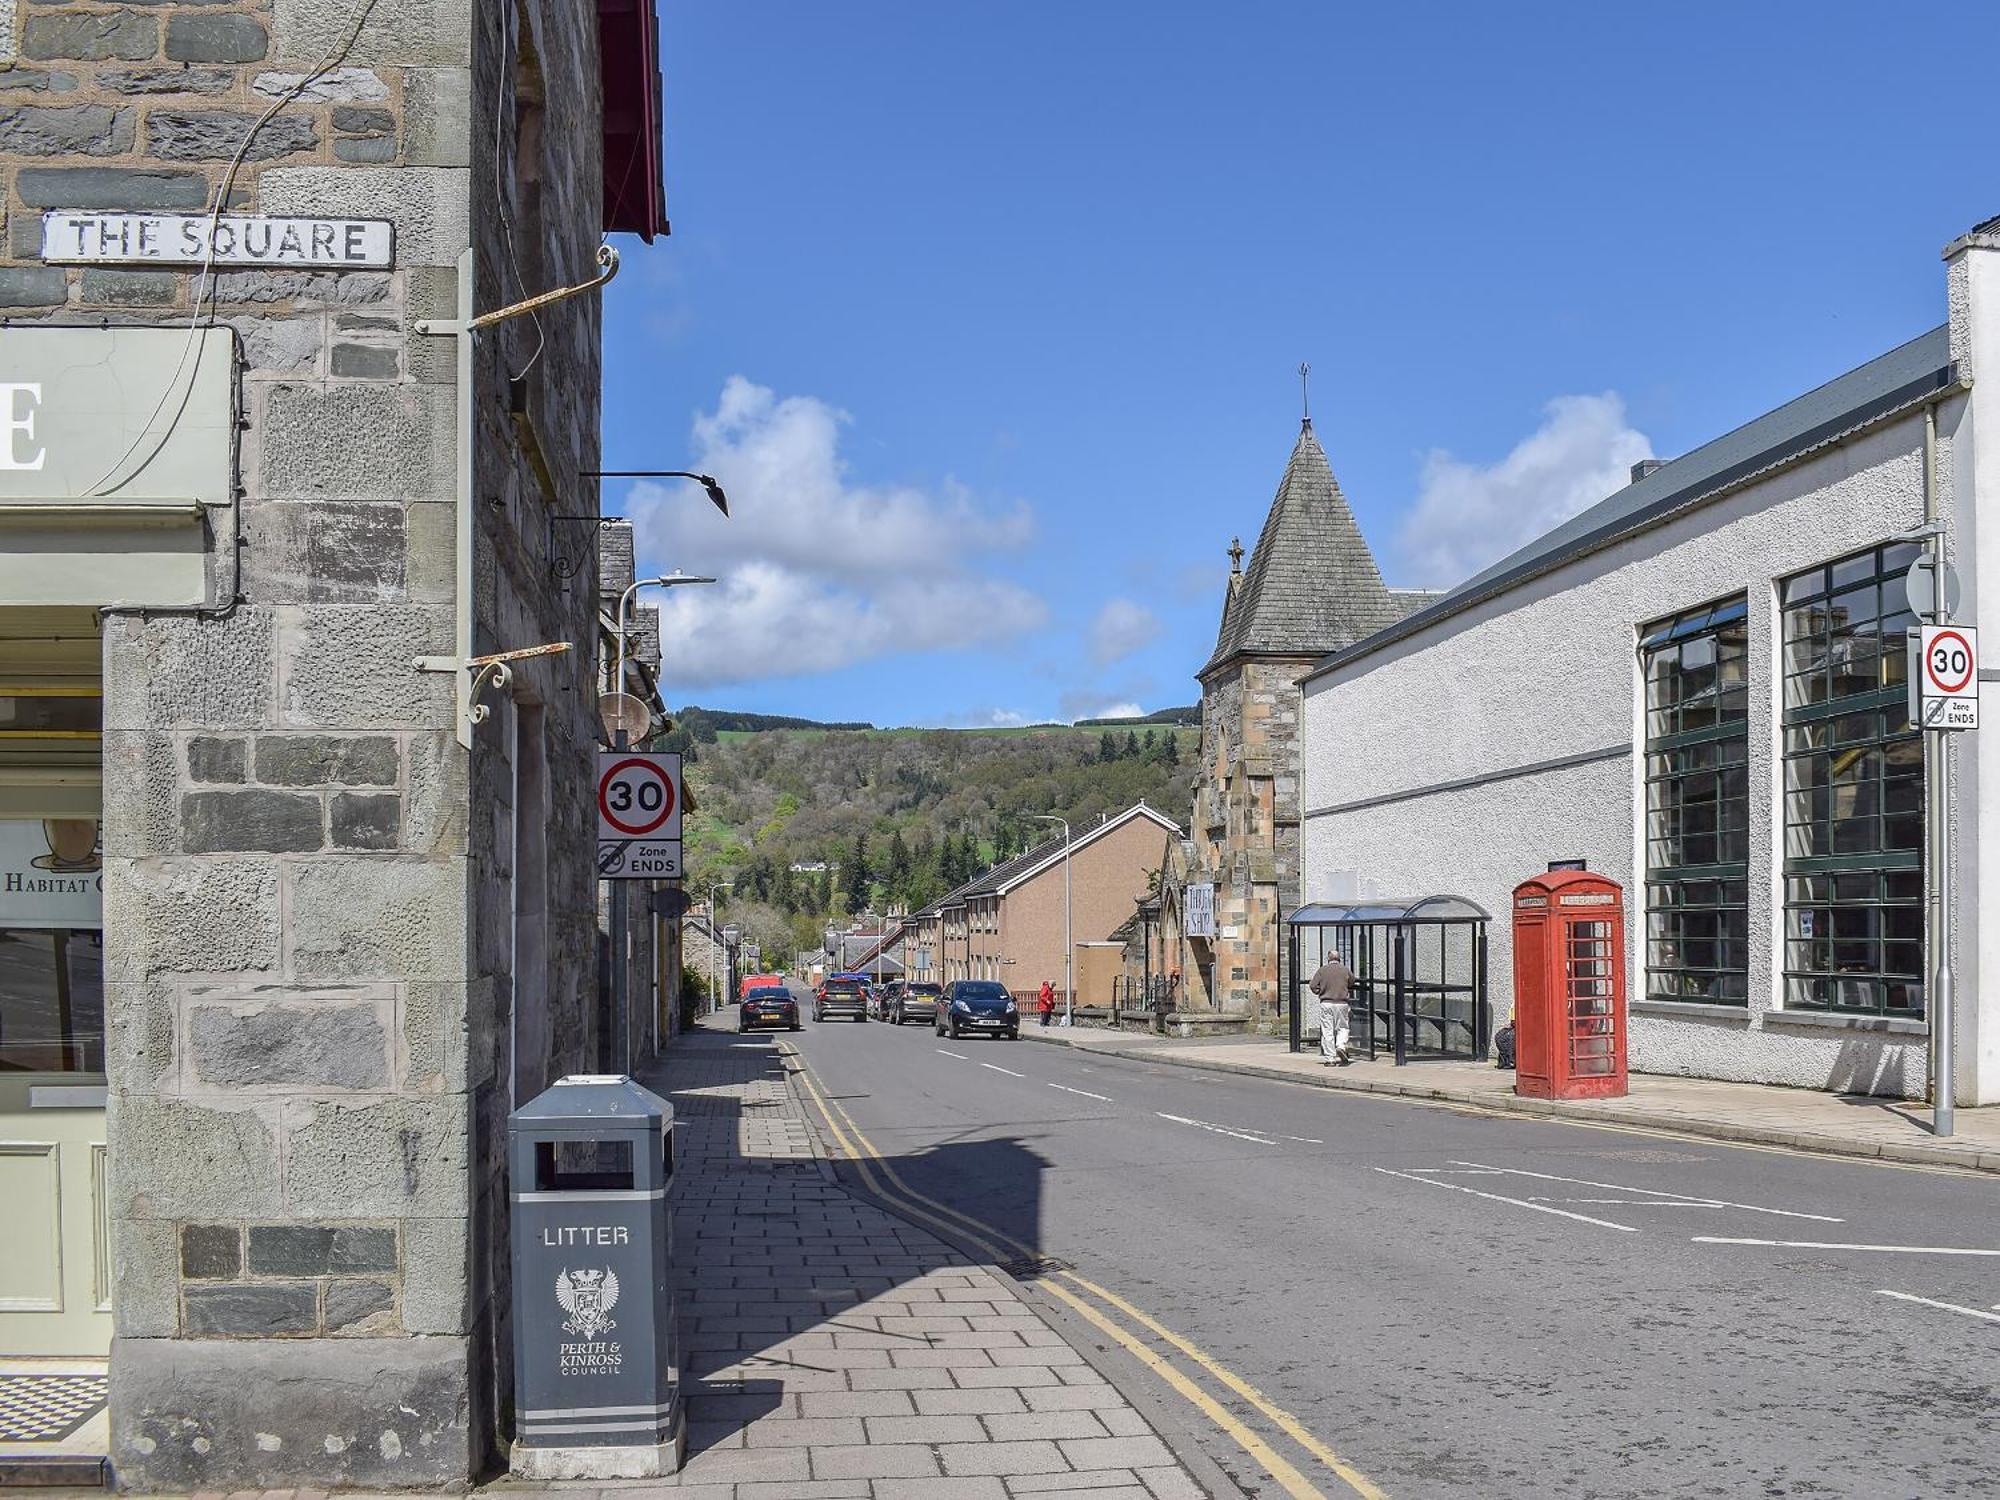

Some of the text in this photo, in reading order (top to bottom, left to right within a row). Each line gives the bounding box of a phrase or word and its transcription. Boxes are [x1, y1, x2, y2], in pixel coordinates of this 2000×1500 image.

[68, 219, 367, 261] THE SQUARE
[0, 383, 46, 471] E
[1933, 648, 1966, 674] 30
[1952, 702, 1970, 711] Zone
[1948, 713, 1975, 724] ENDS
[609, 780, 663, 812] 30
[639, 846, 667, 857] Zone
[631, 860, 675, 872] ENDS
[544, 1226, 629, 1246] LITTER
[560, 1341, 621, 1355] PERTH &
[560, 1353, 622, 1367] KINROSS
[561, 1366, 621, 1376] COUNCIL
